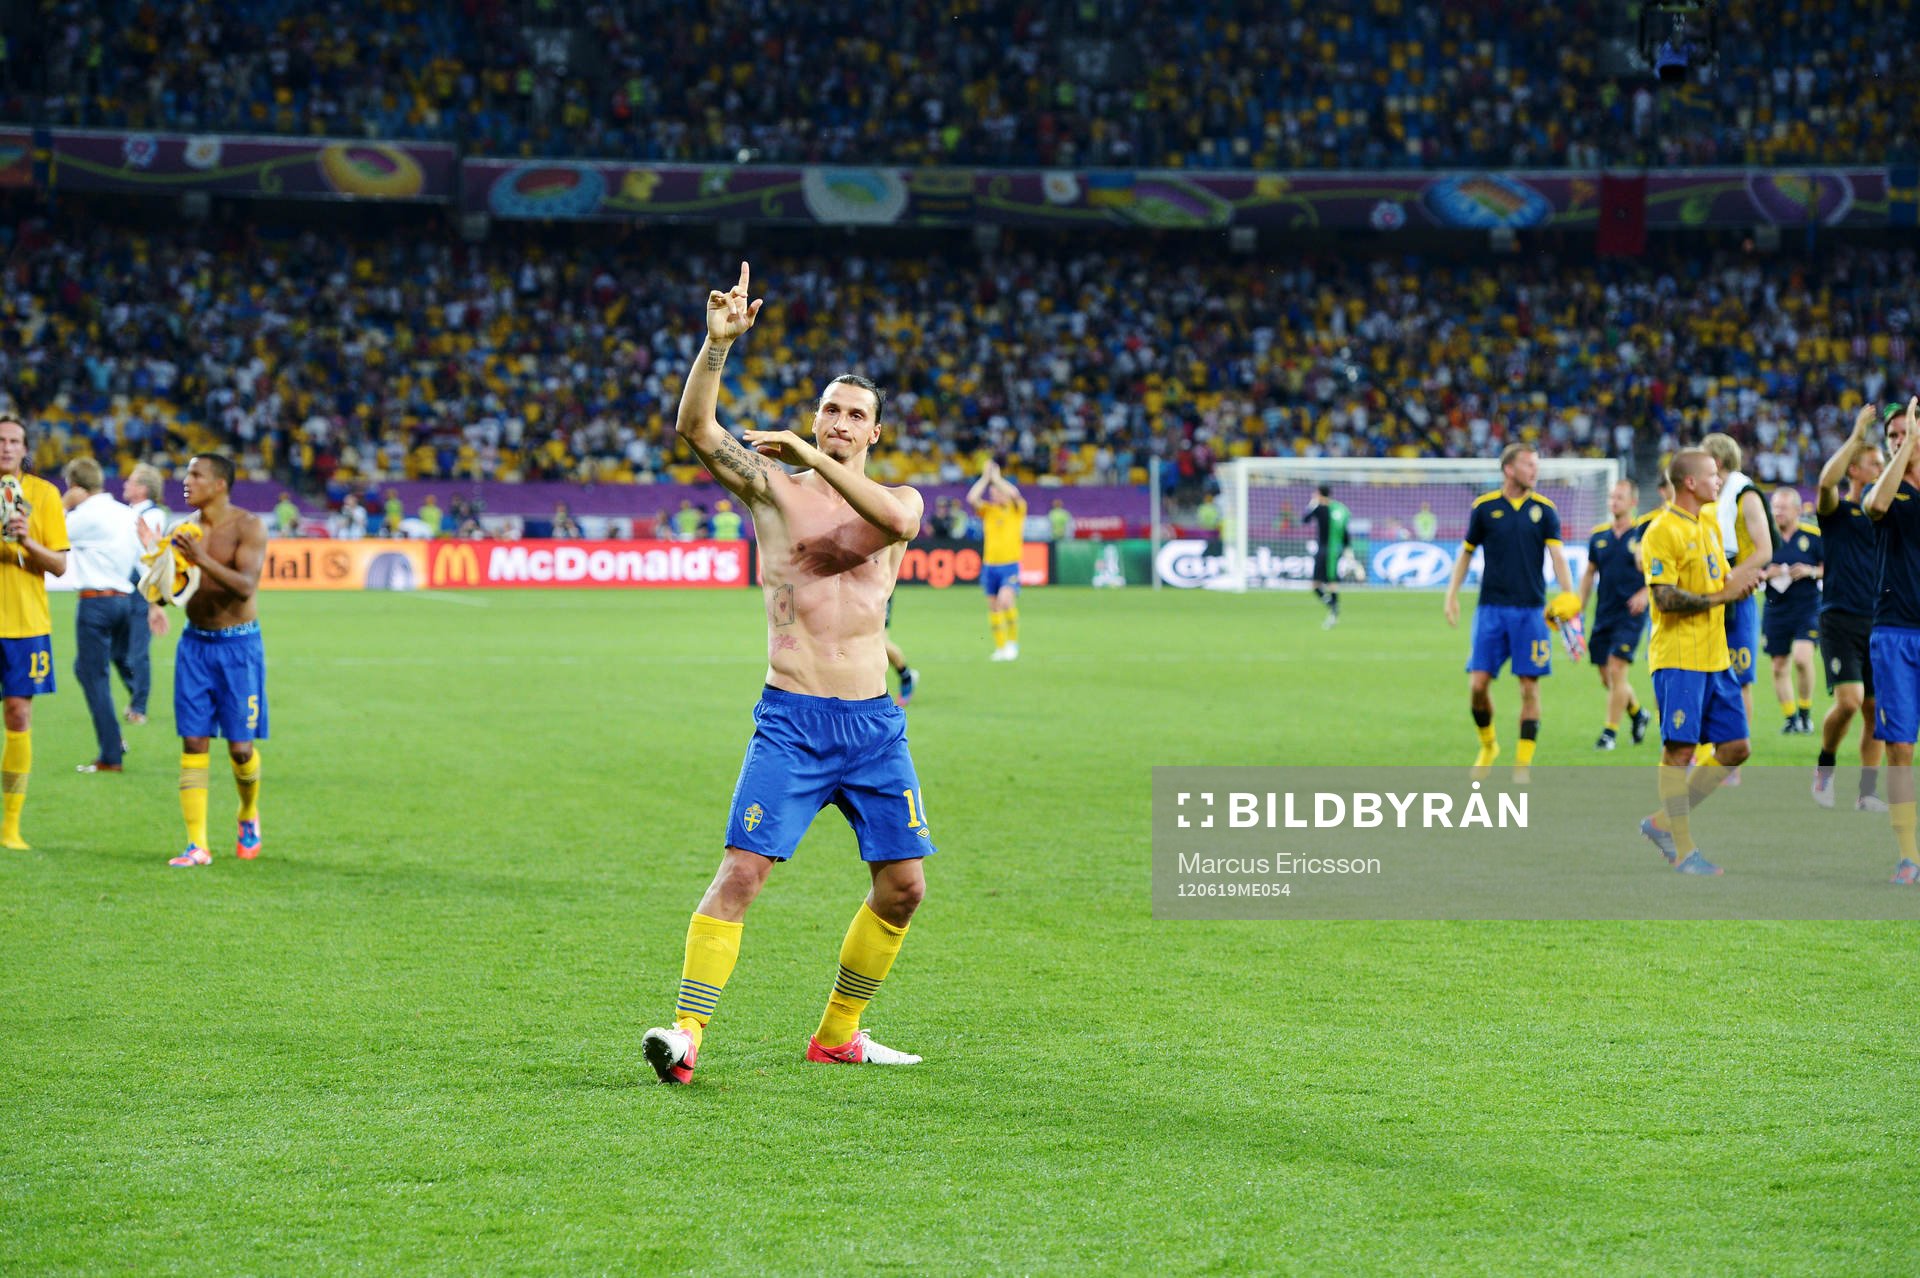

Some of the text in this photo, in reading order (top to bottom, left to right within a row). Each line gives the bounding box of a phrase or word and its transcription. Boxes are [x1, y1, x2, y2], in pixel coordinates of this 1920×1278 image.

[488, 547, 740, 581] McDonald's
[898, 548, 982, 589] nge
[1156, 540, 1318, 588] Carlsber
[29, 650, 50, 678] 13
[1531, 640, 1550, 662] 15
[1728, 647, 1752, 670] 20
[247, 694, 259, 722] 5
[903, 786, 928, 828] 1
